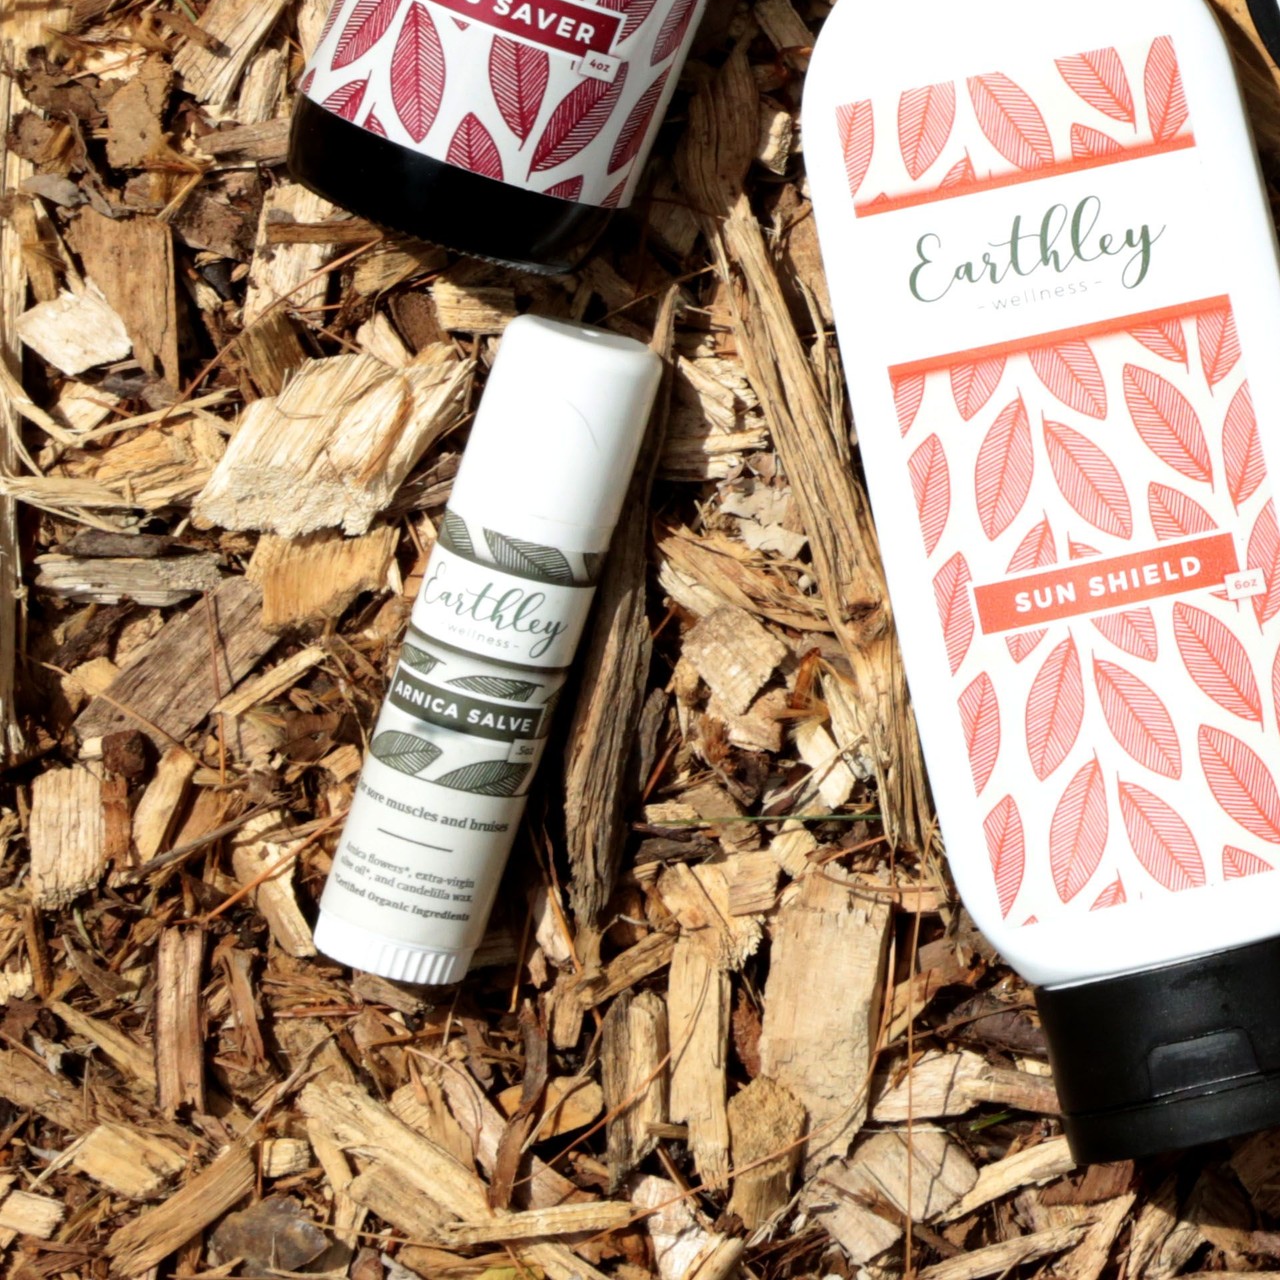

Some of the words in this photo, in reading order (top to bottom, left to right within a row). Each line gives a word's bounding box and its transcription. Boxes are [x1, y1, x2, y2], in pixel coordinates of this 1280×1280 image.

[908, 195, 1166, 303] Earthley
[1014, 582, 1076, 613] SUN
[1088, 556, 1202, 599] SHIELD
[424, 562, 568, 659] Earthley
[395, 681, 458, 718] ARNICA
[467, 709, 532, 732] SALVE
[367, 788, 385, 803] sore
[386, 798, 438, 822] muscles
[441, 816, 468, 828] and
[375, 873, 395, 888] and
[397, 881, 450, 900] candelilla
[415, 871, 475, 888] extra-virgin
[368, 892, 409, 912] Organic
[411, 905, 469, 921] Ingredients
